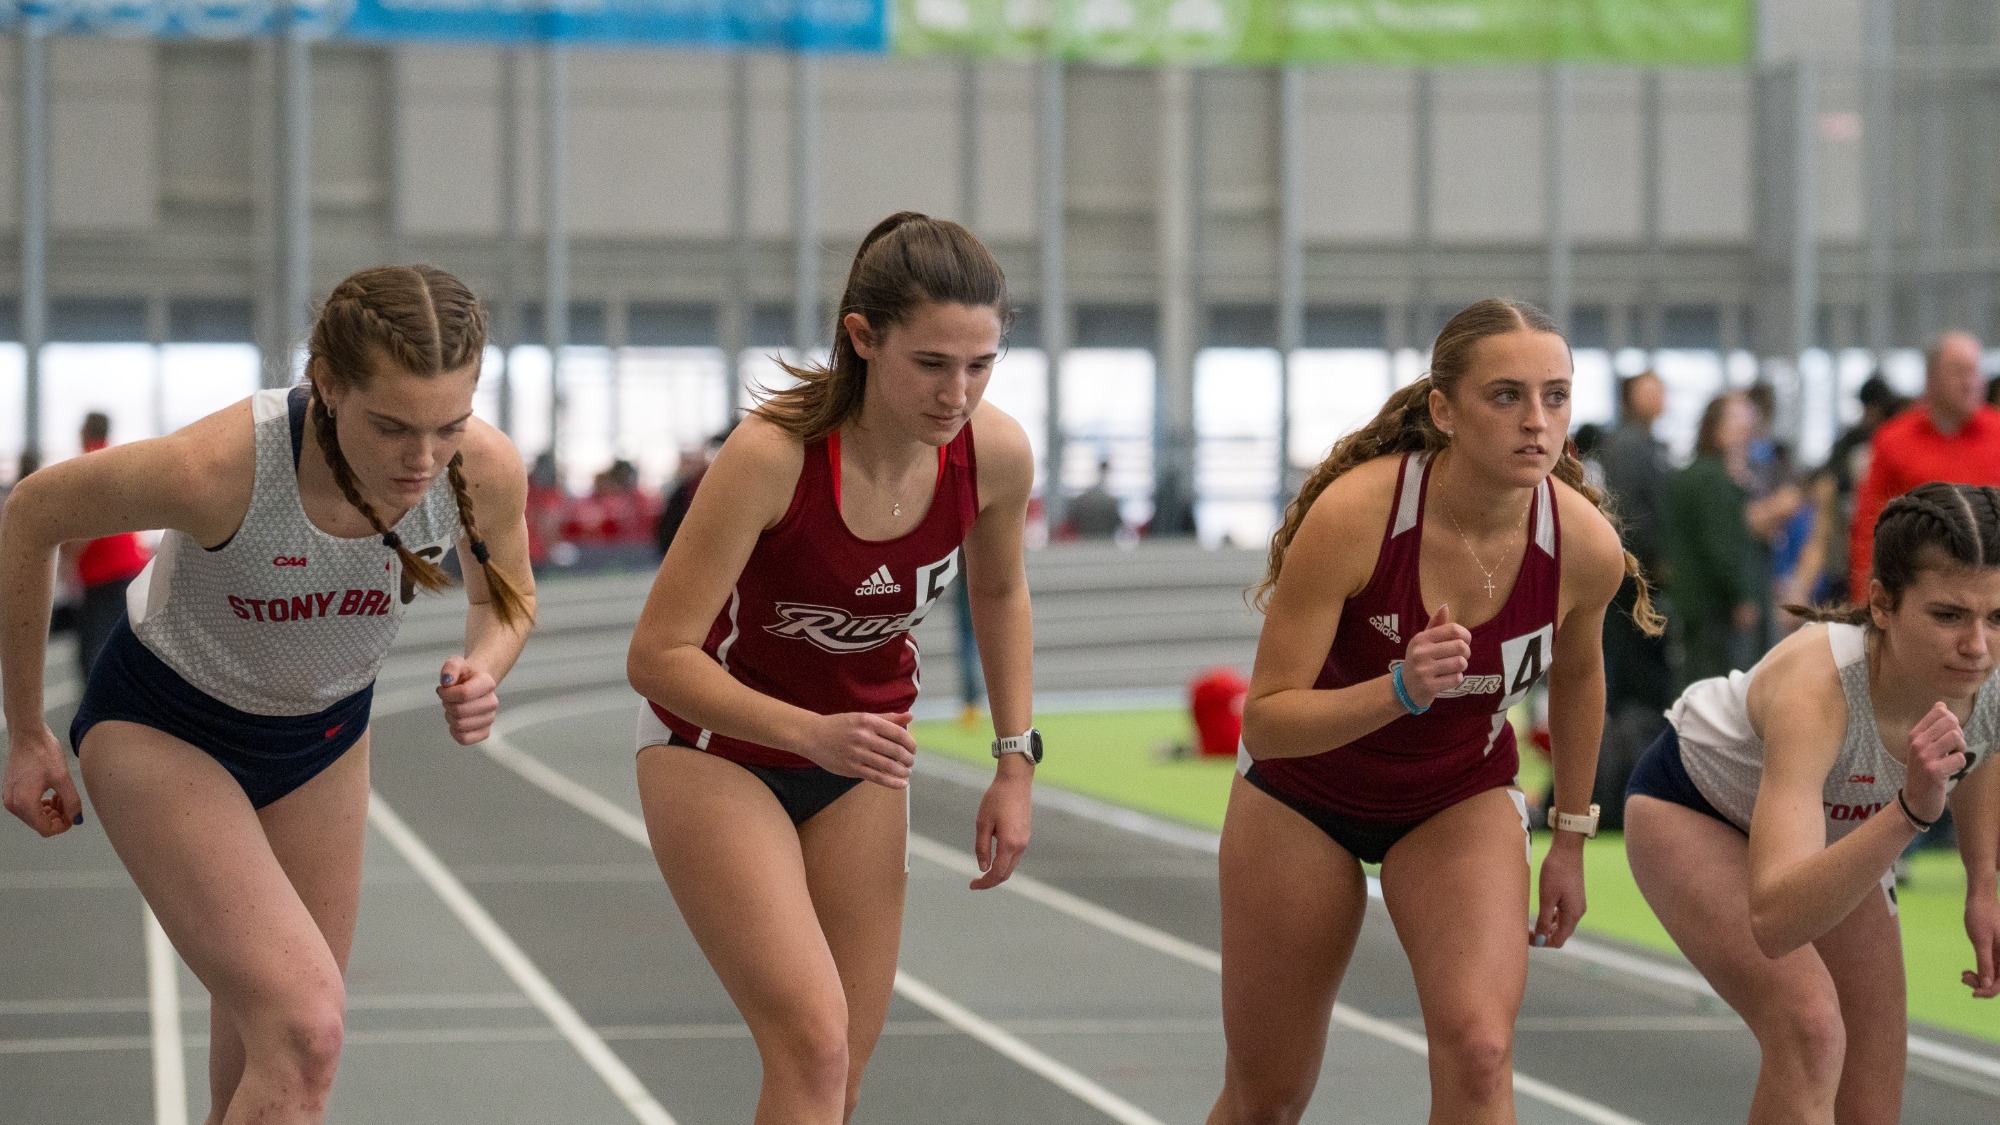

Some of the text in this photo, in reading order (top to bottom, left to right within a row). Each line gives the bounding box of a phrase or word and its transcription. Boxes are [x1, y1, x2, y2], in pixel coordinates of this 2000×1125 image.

[272, 555, 308, 567] CAA
[855, 582, 901, 597] adidas
[227, 590, 338, 623] STONY
[1369, 616, 1402, 644] adidas
[1509, 634, 1545, 697] 4
